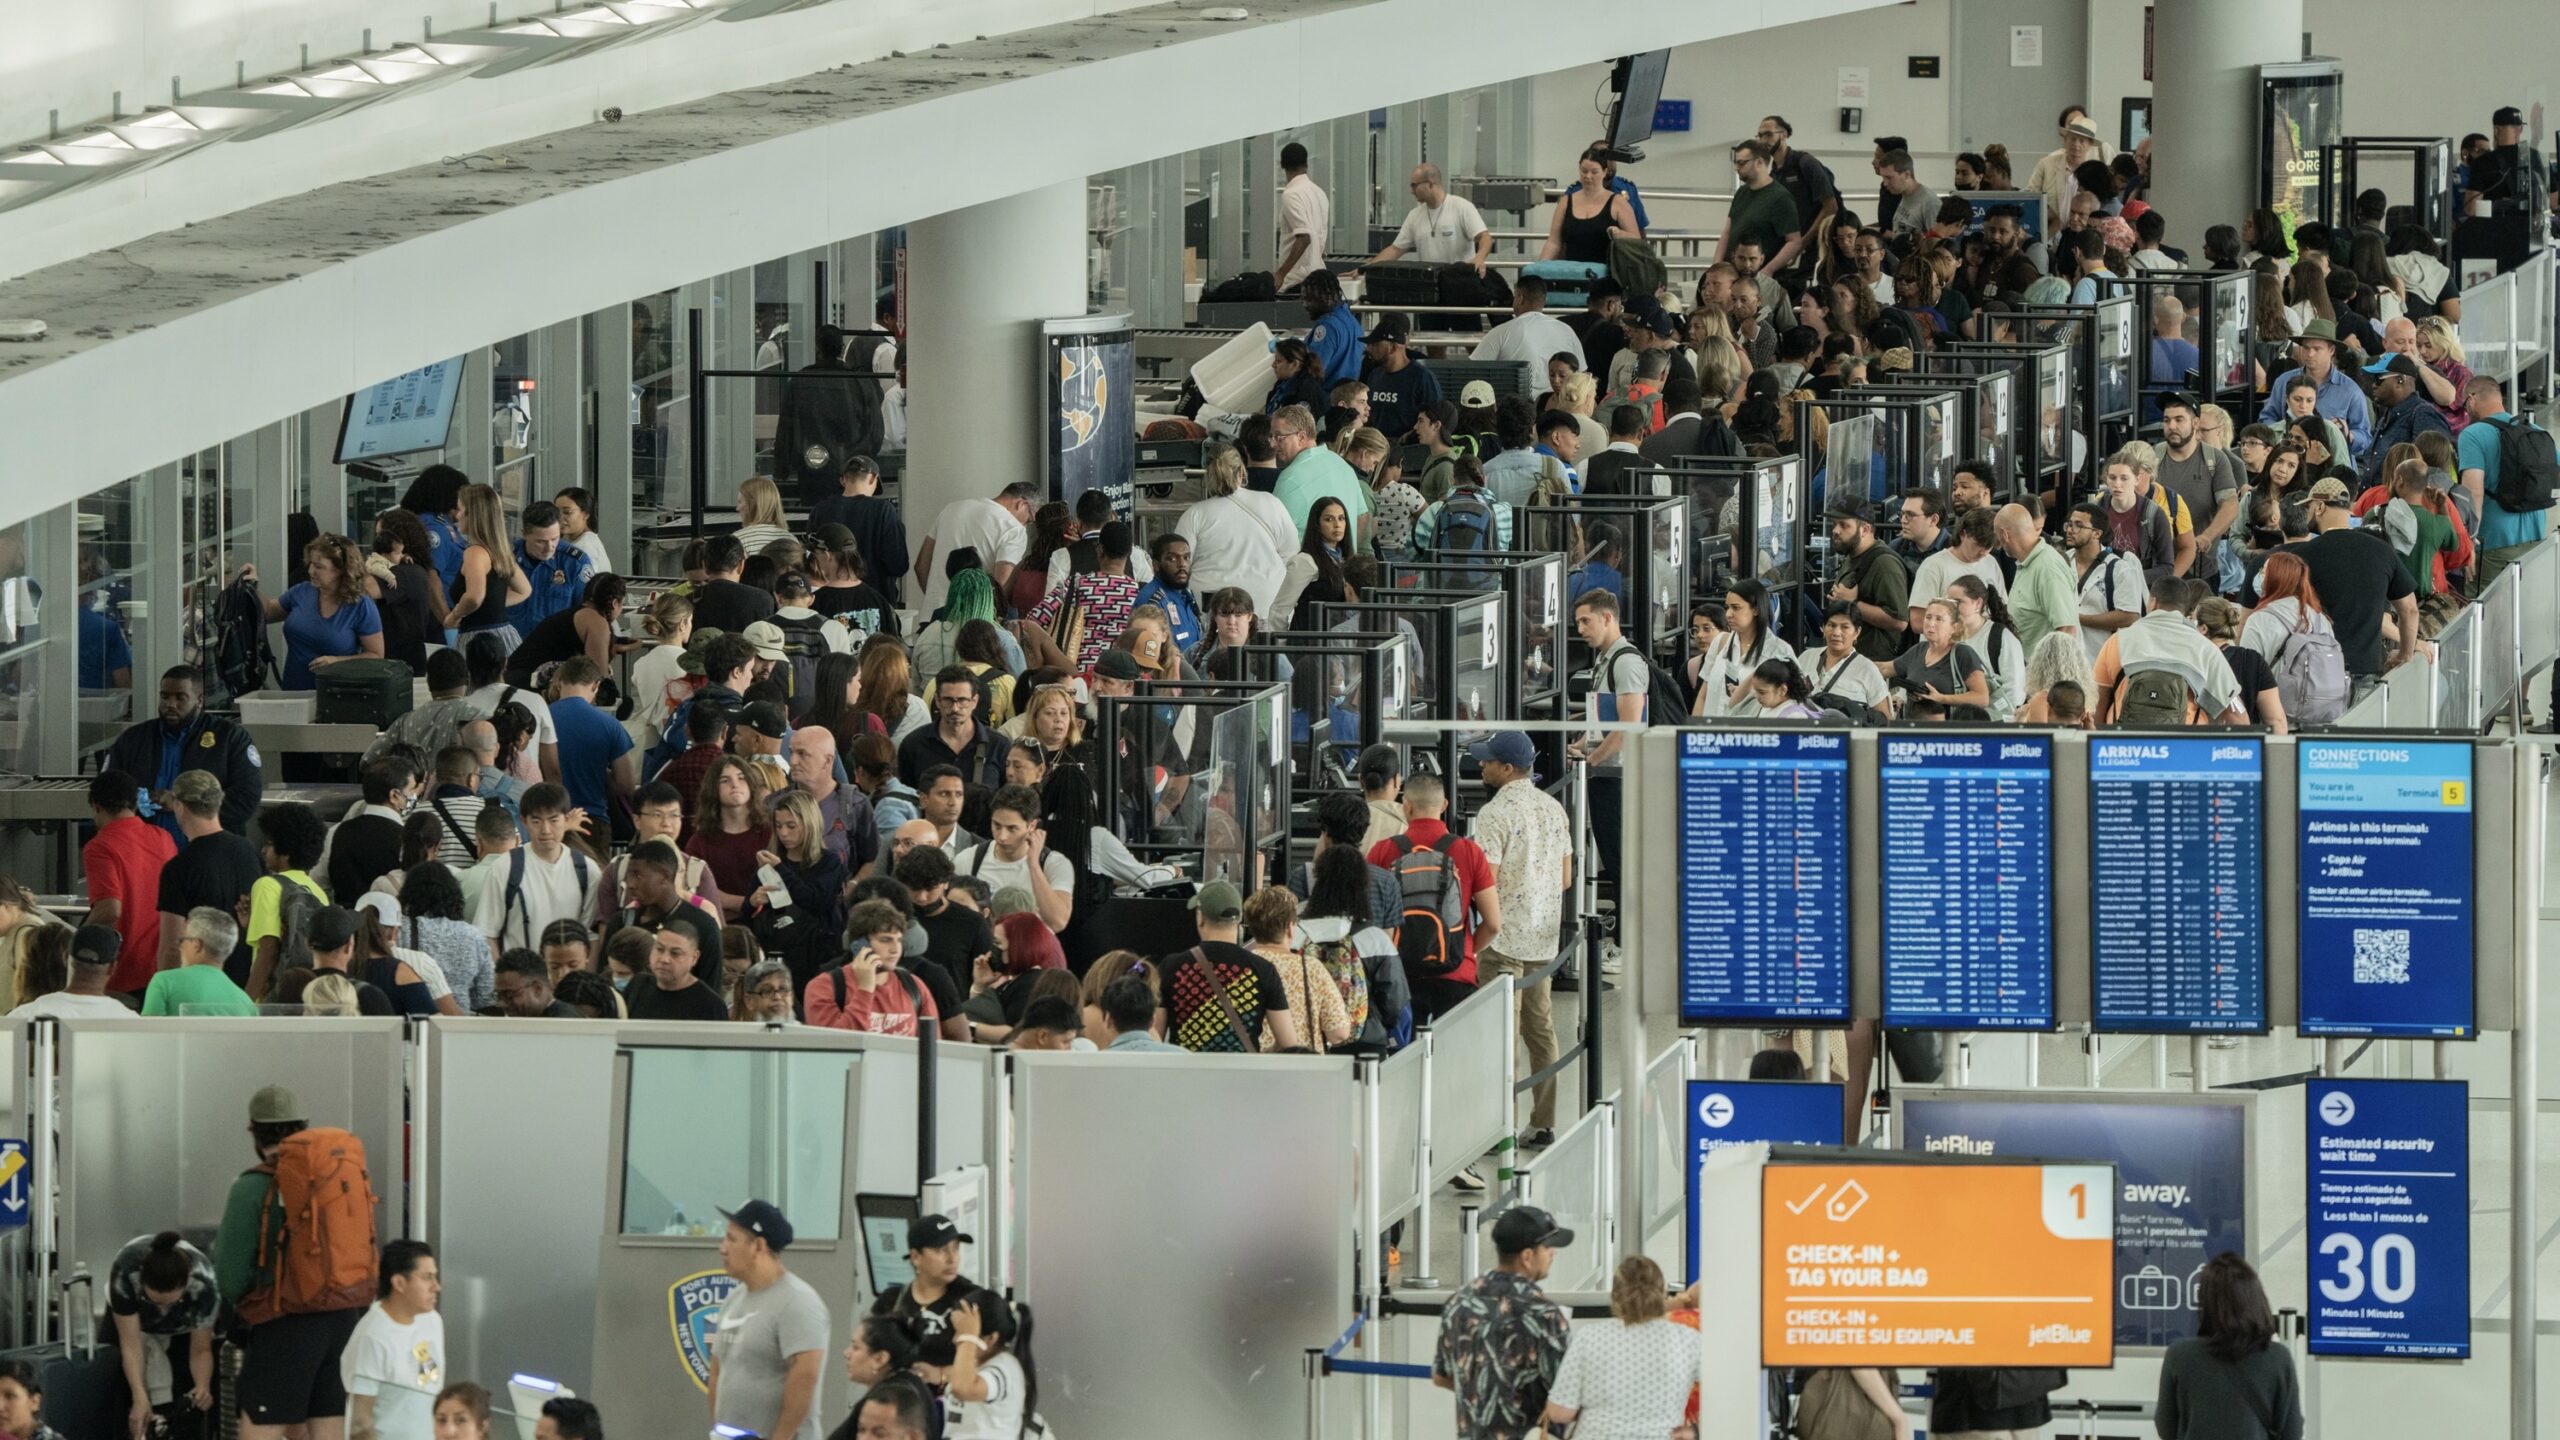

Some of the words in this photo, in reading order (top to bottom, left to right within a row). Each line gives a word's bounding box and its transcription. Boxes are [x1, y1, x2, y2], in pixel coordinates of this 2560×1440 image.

[2240, 295, 2246, 327] 9
[2121, 320, 2129, 353] 8
[2056, 371, 2063, 400] 7
[1372, 391, 1398, 403] BOSS
[1103, 484, 1122, 499] Enjoy
[1786, 482, 1793, 520] 6
[1673, 534, 1680, 564] 5
[1548, 583, 1556, 621] 4
[1487, 623, 1495, 663] 3
[1687, 733, 1780, 747] DEPARTURES
[1798, 735, 1839, 750] jetBlue
[1687, 746, 1720, 754] SALIDAS
[1888, 743, 1982, 757] DEPARTURES
[2000, 744, 2042, 759] jetBlue
[2098, 746, 2169, 758] ARRIVALS
[2212, 746, 2253, 762] jetBlue
[2309, 748, 2409, 762] CONNECTIONS
[1888, 756, 1923, 764] SALIDAS
[2099, 758, 2140, 766] LLEGADAS
[2309, 761, 2359, 769] CONEXIONES
[2309, 783, 2326, 791] You
[2345, 782, 2354, 791] in
[2398, 789, 2439, 798] Terminal
[2449, 788, 2458, 800] 5
[2308, 822, 2348, 832] Airlines
[2350, 822, 2360, 832] in
[2361, 822, 2381, 832] this
[2382, 823, 2429, 833] terminal:
[2365, 837, 2382, 845] esta
[2383, 837, 2421, 846] terminal:
[2327, 854, 2351, 866] Cape
[2352, 855, 2367, 865] Air
[2327, 867, 2364, 877] JetBlue
[2308, 886, 2326, 895] Scan
[2327, 887, 2337, 895] for
[2338, 887, 2349, 895] all
[2350, 887, 2368, 895] other
[2370, 887, 2392, 896] airline
[1925, 1135, 1993, 1155] jetBlue
[2320, 1136, 2381, 1149] Estimated
[2383, 1138, 2434, 1152] security
[2320, 1150, 2346, 1161] wait
[2348, 1151, 2376, 1162] time
[2124, 1184, 2191, 1208] away.
[2320, 1183, 2352, 1194] Tiempo
[2354, 1185, 2394, 1194] estimado
[2395, 1185, 2407, 1194] de
[2069, 1183, 2086, 1220] 1
[2320, 1196, 2350, 1204] espera
[2365, 1196, 2412, 1206] seguridad:
[2147, 1215, 2164, 1223] fare
[2166, 1217, 2184, 1225] may
[2323, 1211, 2347, 1221] Less
[2349, 1211, 2372, 1222] than
[2380, 1213, 2414, 1223] menos
[2416, 1213, 2429, 1223] de
[2122, 1227, 2134, 1235] bin
[2150, 1228, 2187, 1237] personal
[2188, 1227, 2208, 1237] item
[2149, 1239, 2165, 1247] that
[1786, 1245, 1885, 1264] CHECK-IN
[2319, 1232, 2416, 1304] 30
[1786, 1268, 1826, 1287] TAG
[1829, 1268, 1883, 1287] YOUR
[1887, 1268, 1928, 1287] BAG
[681, 1277, 707, 1294] PORT
[1786, 1309, 1866, 1326] CHECK-IN
[2321, 1308, 2359, 1318] Minutes
[2366, 1308, 2405, 1319] Minutos
[1786, 1328, 1866, 1345] ETIQUETE
[1868, 1328, 1892, 1344] SU
[1895, 1328, 1975, 1345] EQUIPAJE
[2028, 1324, 2091, 1347] jetBlue
[678, 1323, 694, 1349] NEW
[688, 1352, 710, 1381] YORK
